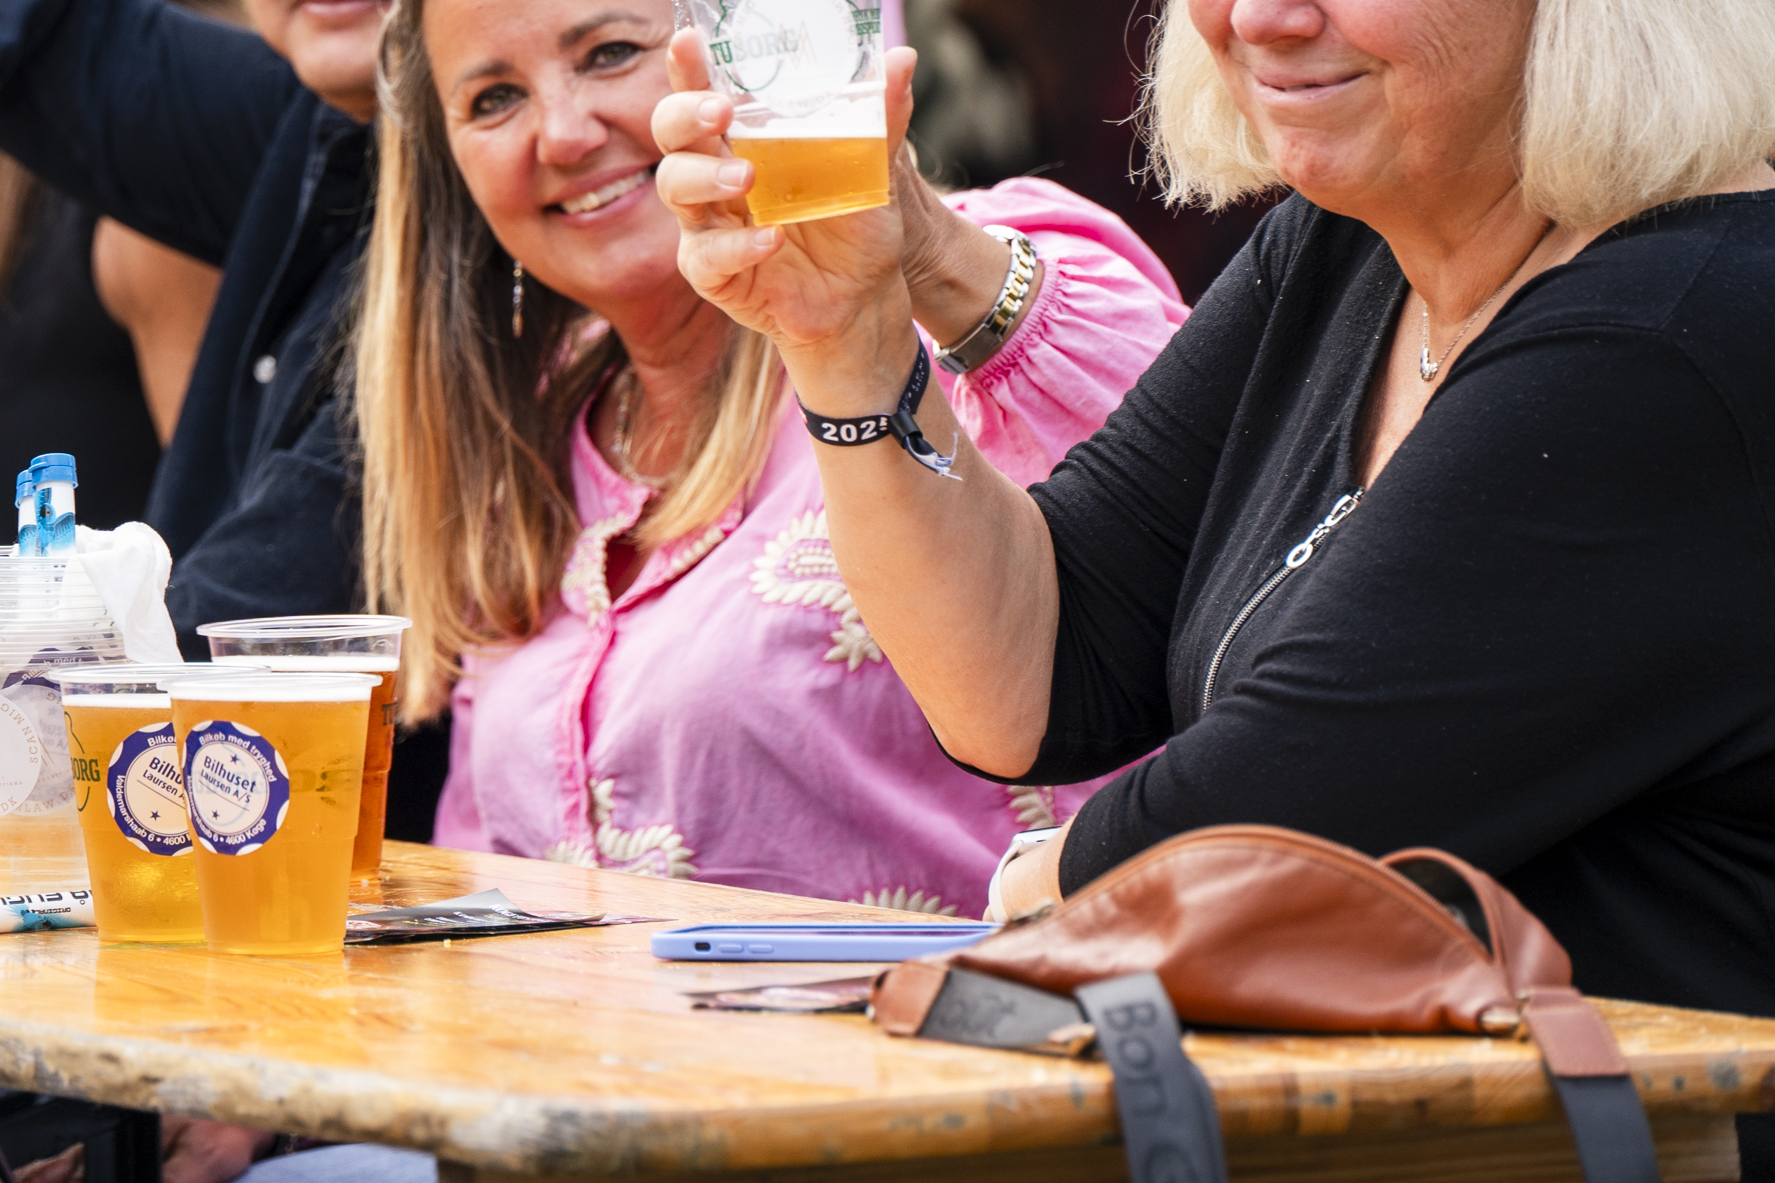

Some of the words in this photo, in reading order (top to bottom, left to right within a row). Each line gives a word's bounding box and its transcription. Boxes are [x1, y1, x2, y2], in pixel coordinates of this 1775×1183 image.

[0, 702, 25, 725] MIG
[22, 726, 38, 764] SCAN
[228, 734, 251, 749] med
[250, 745, 277, 783] tryghed
[142, 769, 178, 796] Laursen
[149, 756, 182, 785] Bilhu
[203, 756, 257, 793] Bilhuset
[200, 769, 231, 794] Laursen
[233, 789, 251, 803] A/S
[148, 834, 155, 842] 6
[163, 835, 185, 845] 4600
[213, 833, 219, 842] 6
[226, 833, 246, 845] 4600
